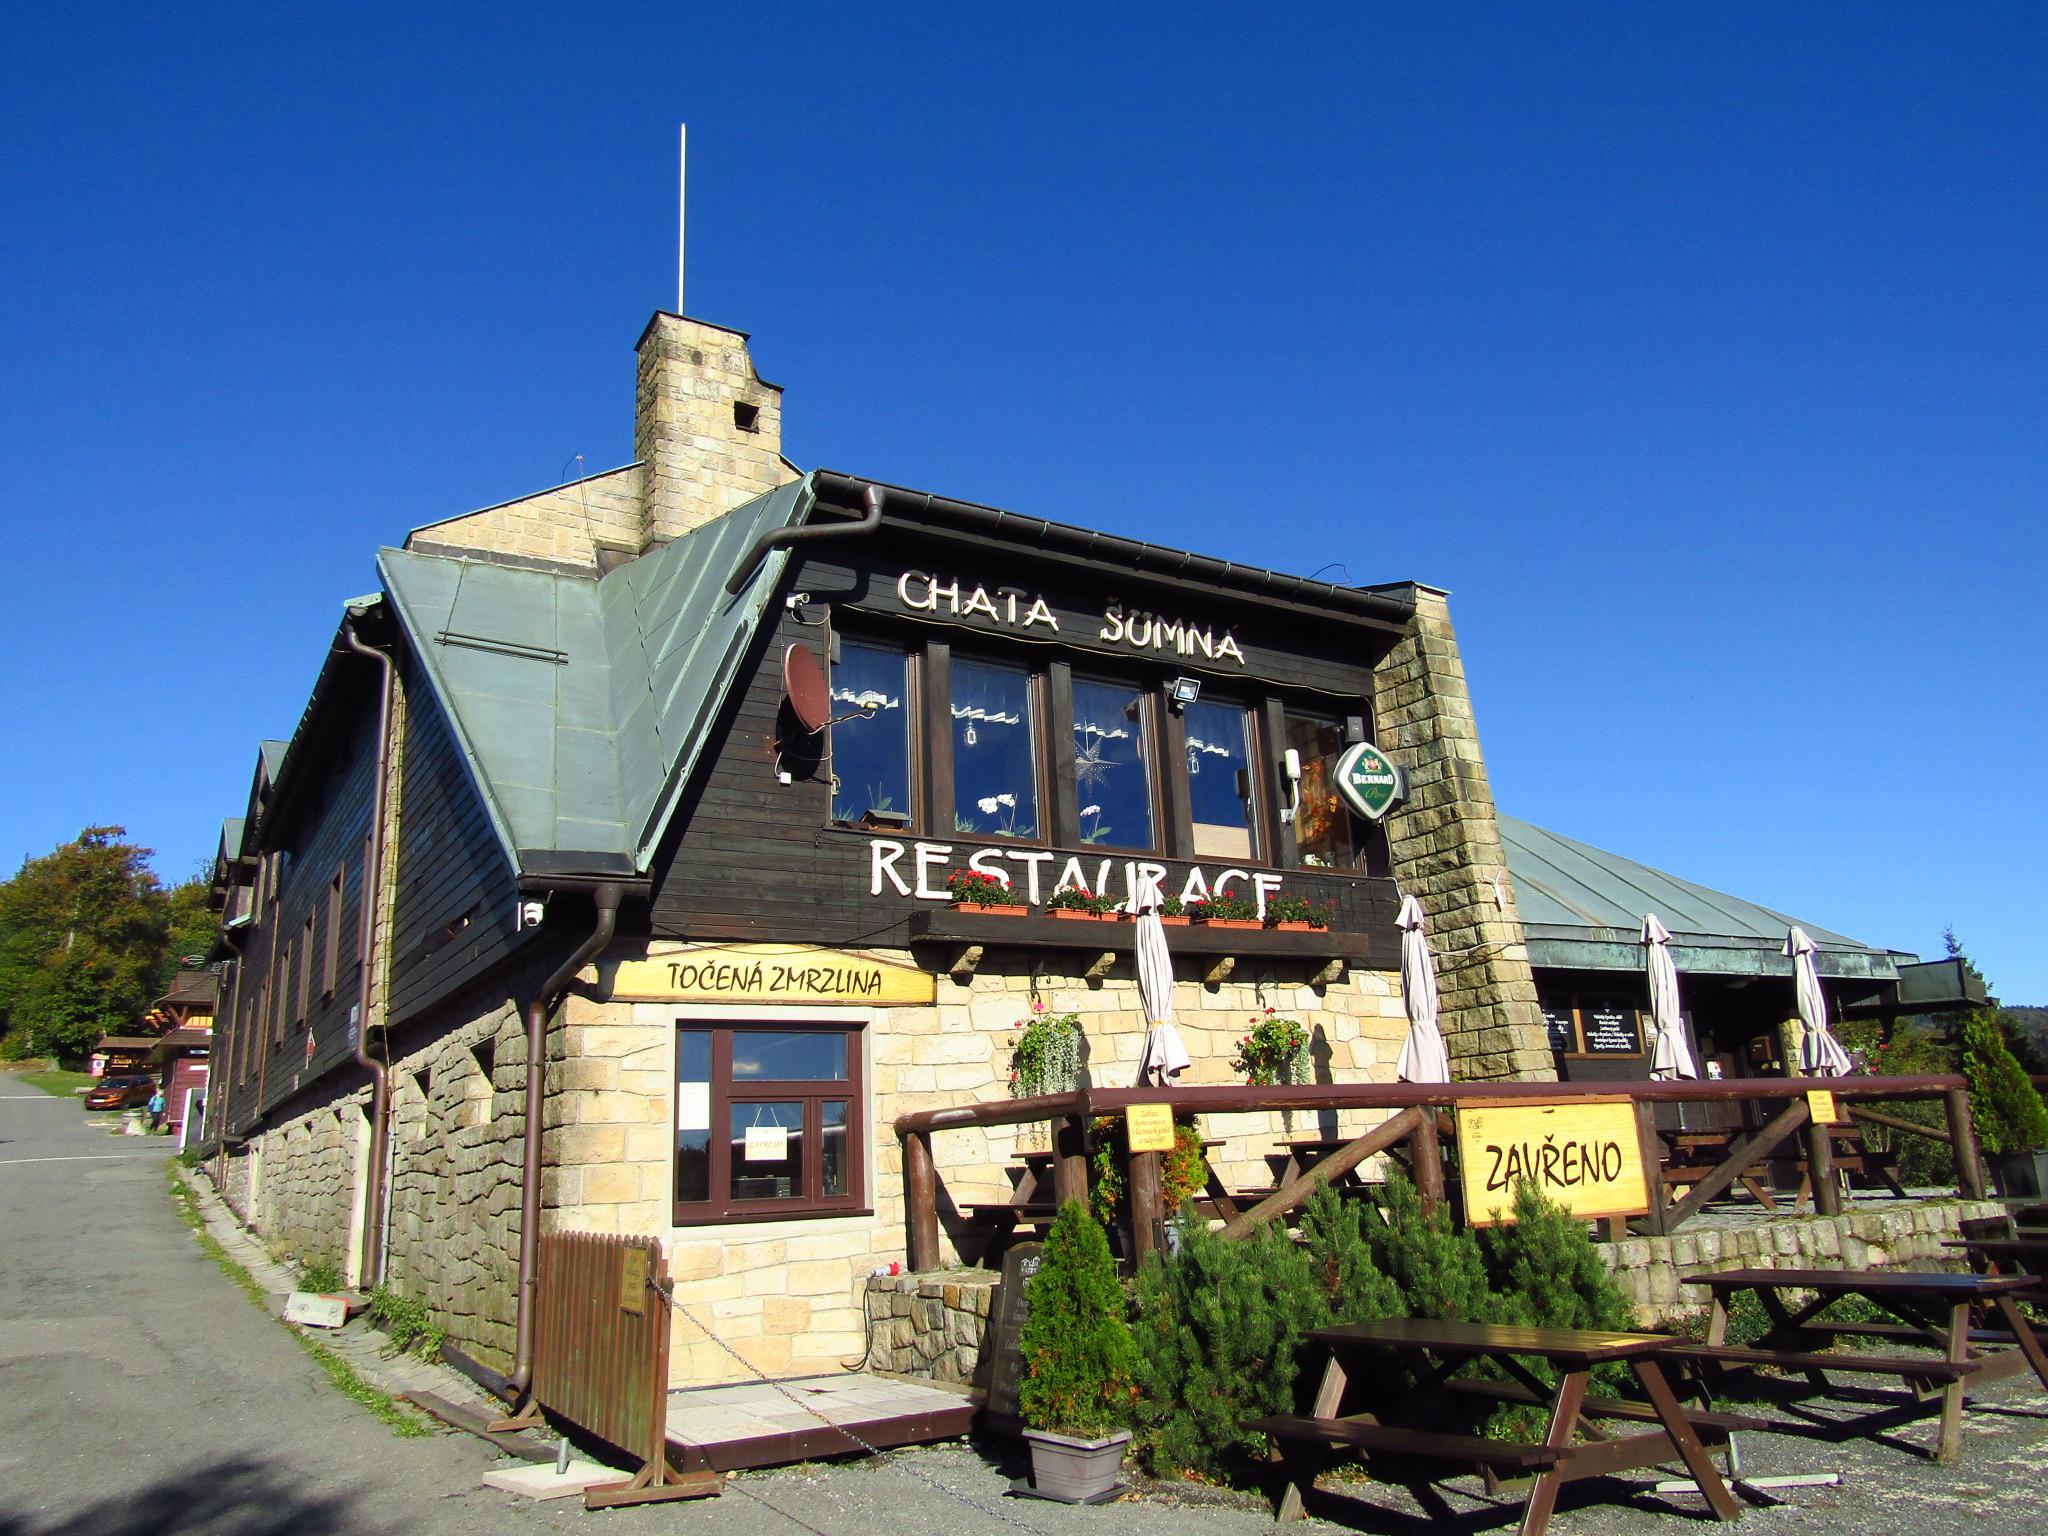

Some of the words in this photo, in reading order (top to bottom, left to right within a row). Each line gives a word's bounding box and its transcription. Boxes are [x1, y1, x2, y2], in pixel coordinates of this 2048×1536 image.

[898, 570, 1059, 632] CHATA
[1352, 773, 1394, 785] BERNARD
[667, 960, 763, 992] TOČENÁ
[769, 966, 882, 995] ZMRZLINA
[1486, 1133, 1621, 1193] ZAVŘENO
